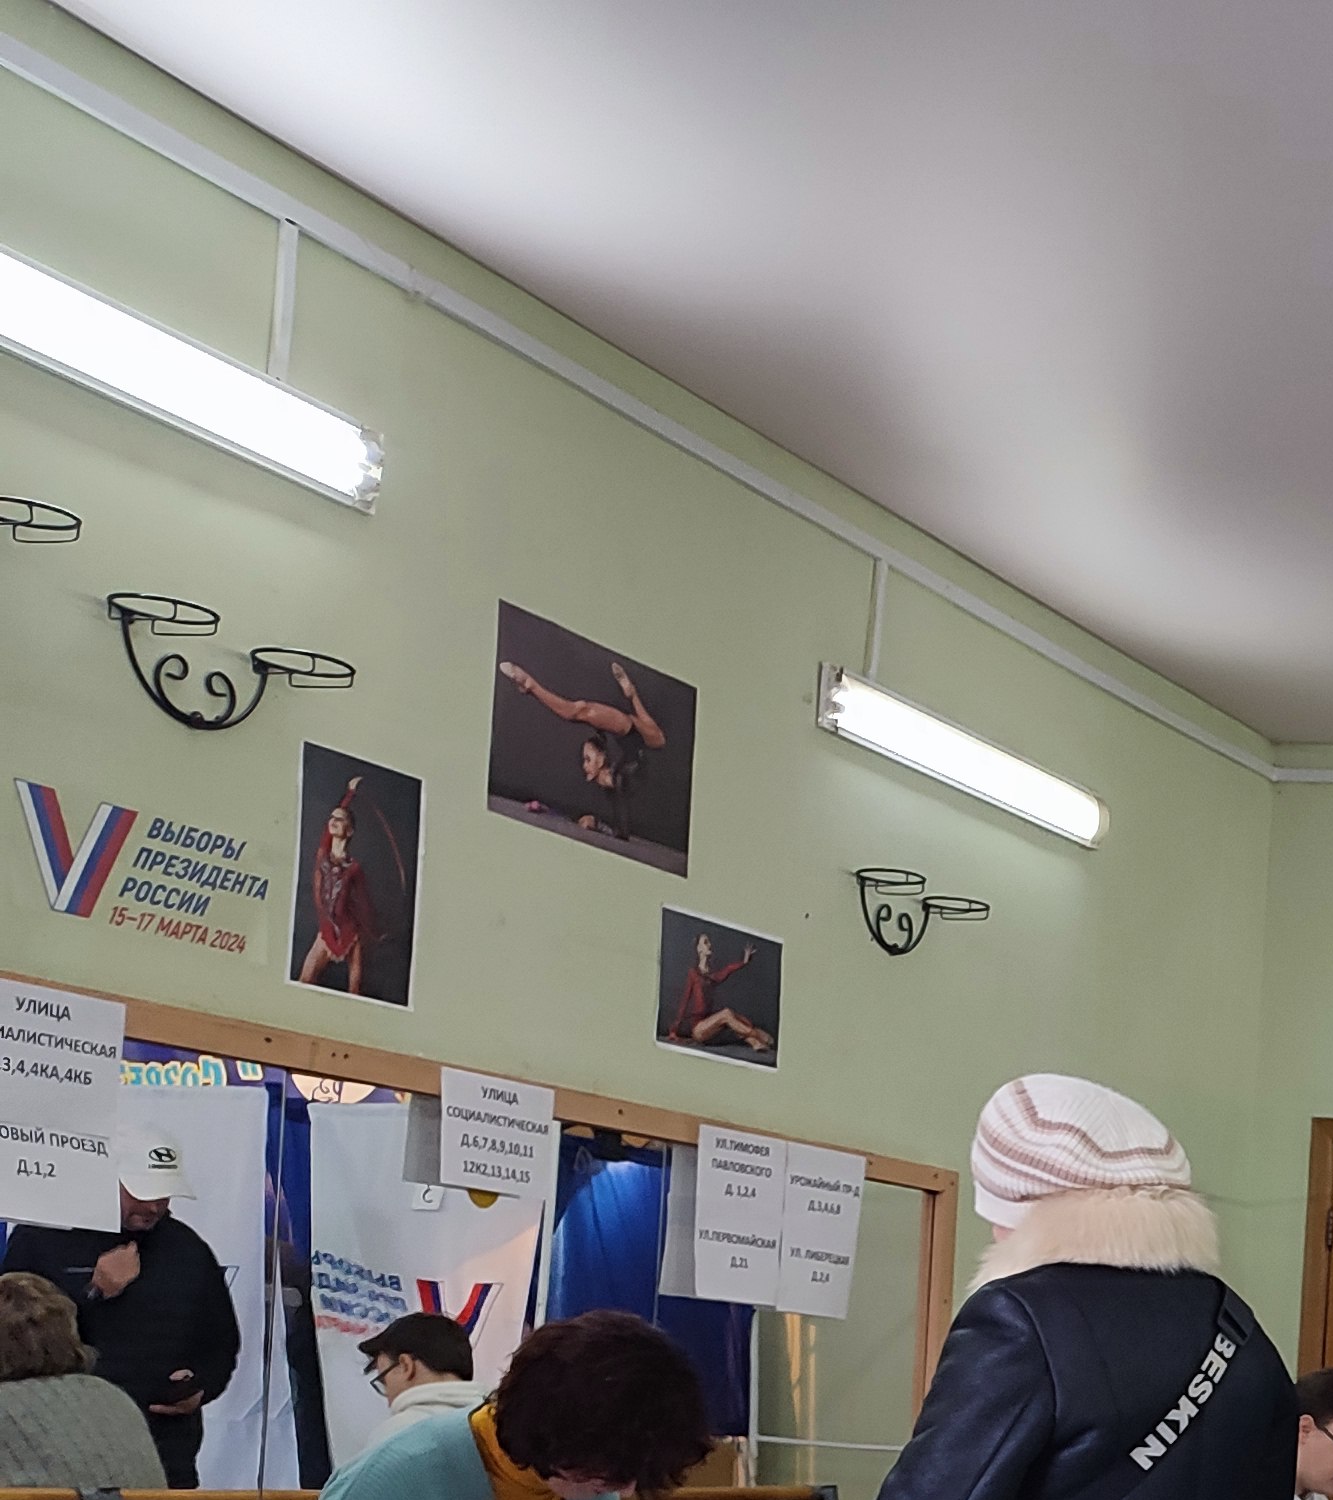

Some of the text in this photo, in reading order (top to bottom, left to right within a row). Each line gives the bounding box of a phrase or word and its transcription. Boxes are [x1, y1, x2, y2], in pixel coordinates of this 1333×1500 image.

[147, 816, 247, 861] ВЫБОРЫ
[132, 846, 270, 900] ПРЕЗИДЕНТА
[118, 876, 211, 917] РОССИИ
[155, 915, 209, 946] МАРТА
[209, 929, 247, 954] 2024
[15, 996, 72, 1022] УЛИЦА
[481, 1085, 519, 1106] УЛИЦА
[446, 1105, 549, 1135] СОЦИАЛИСТИЧЕСКАЯ
[49, 1132, 109, 1158] ПРОЕЗД
[1128, 1331, 1238, 1472] BESKIN
